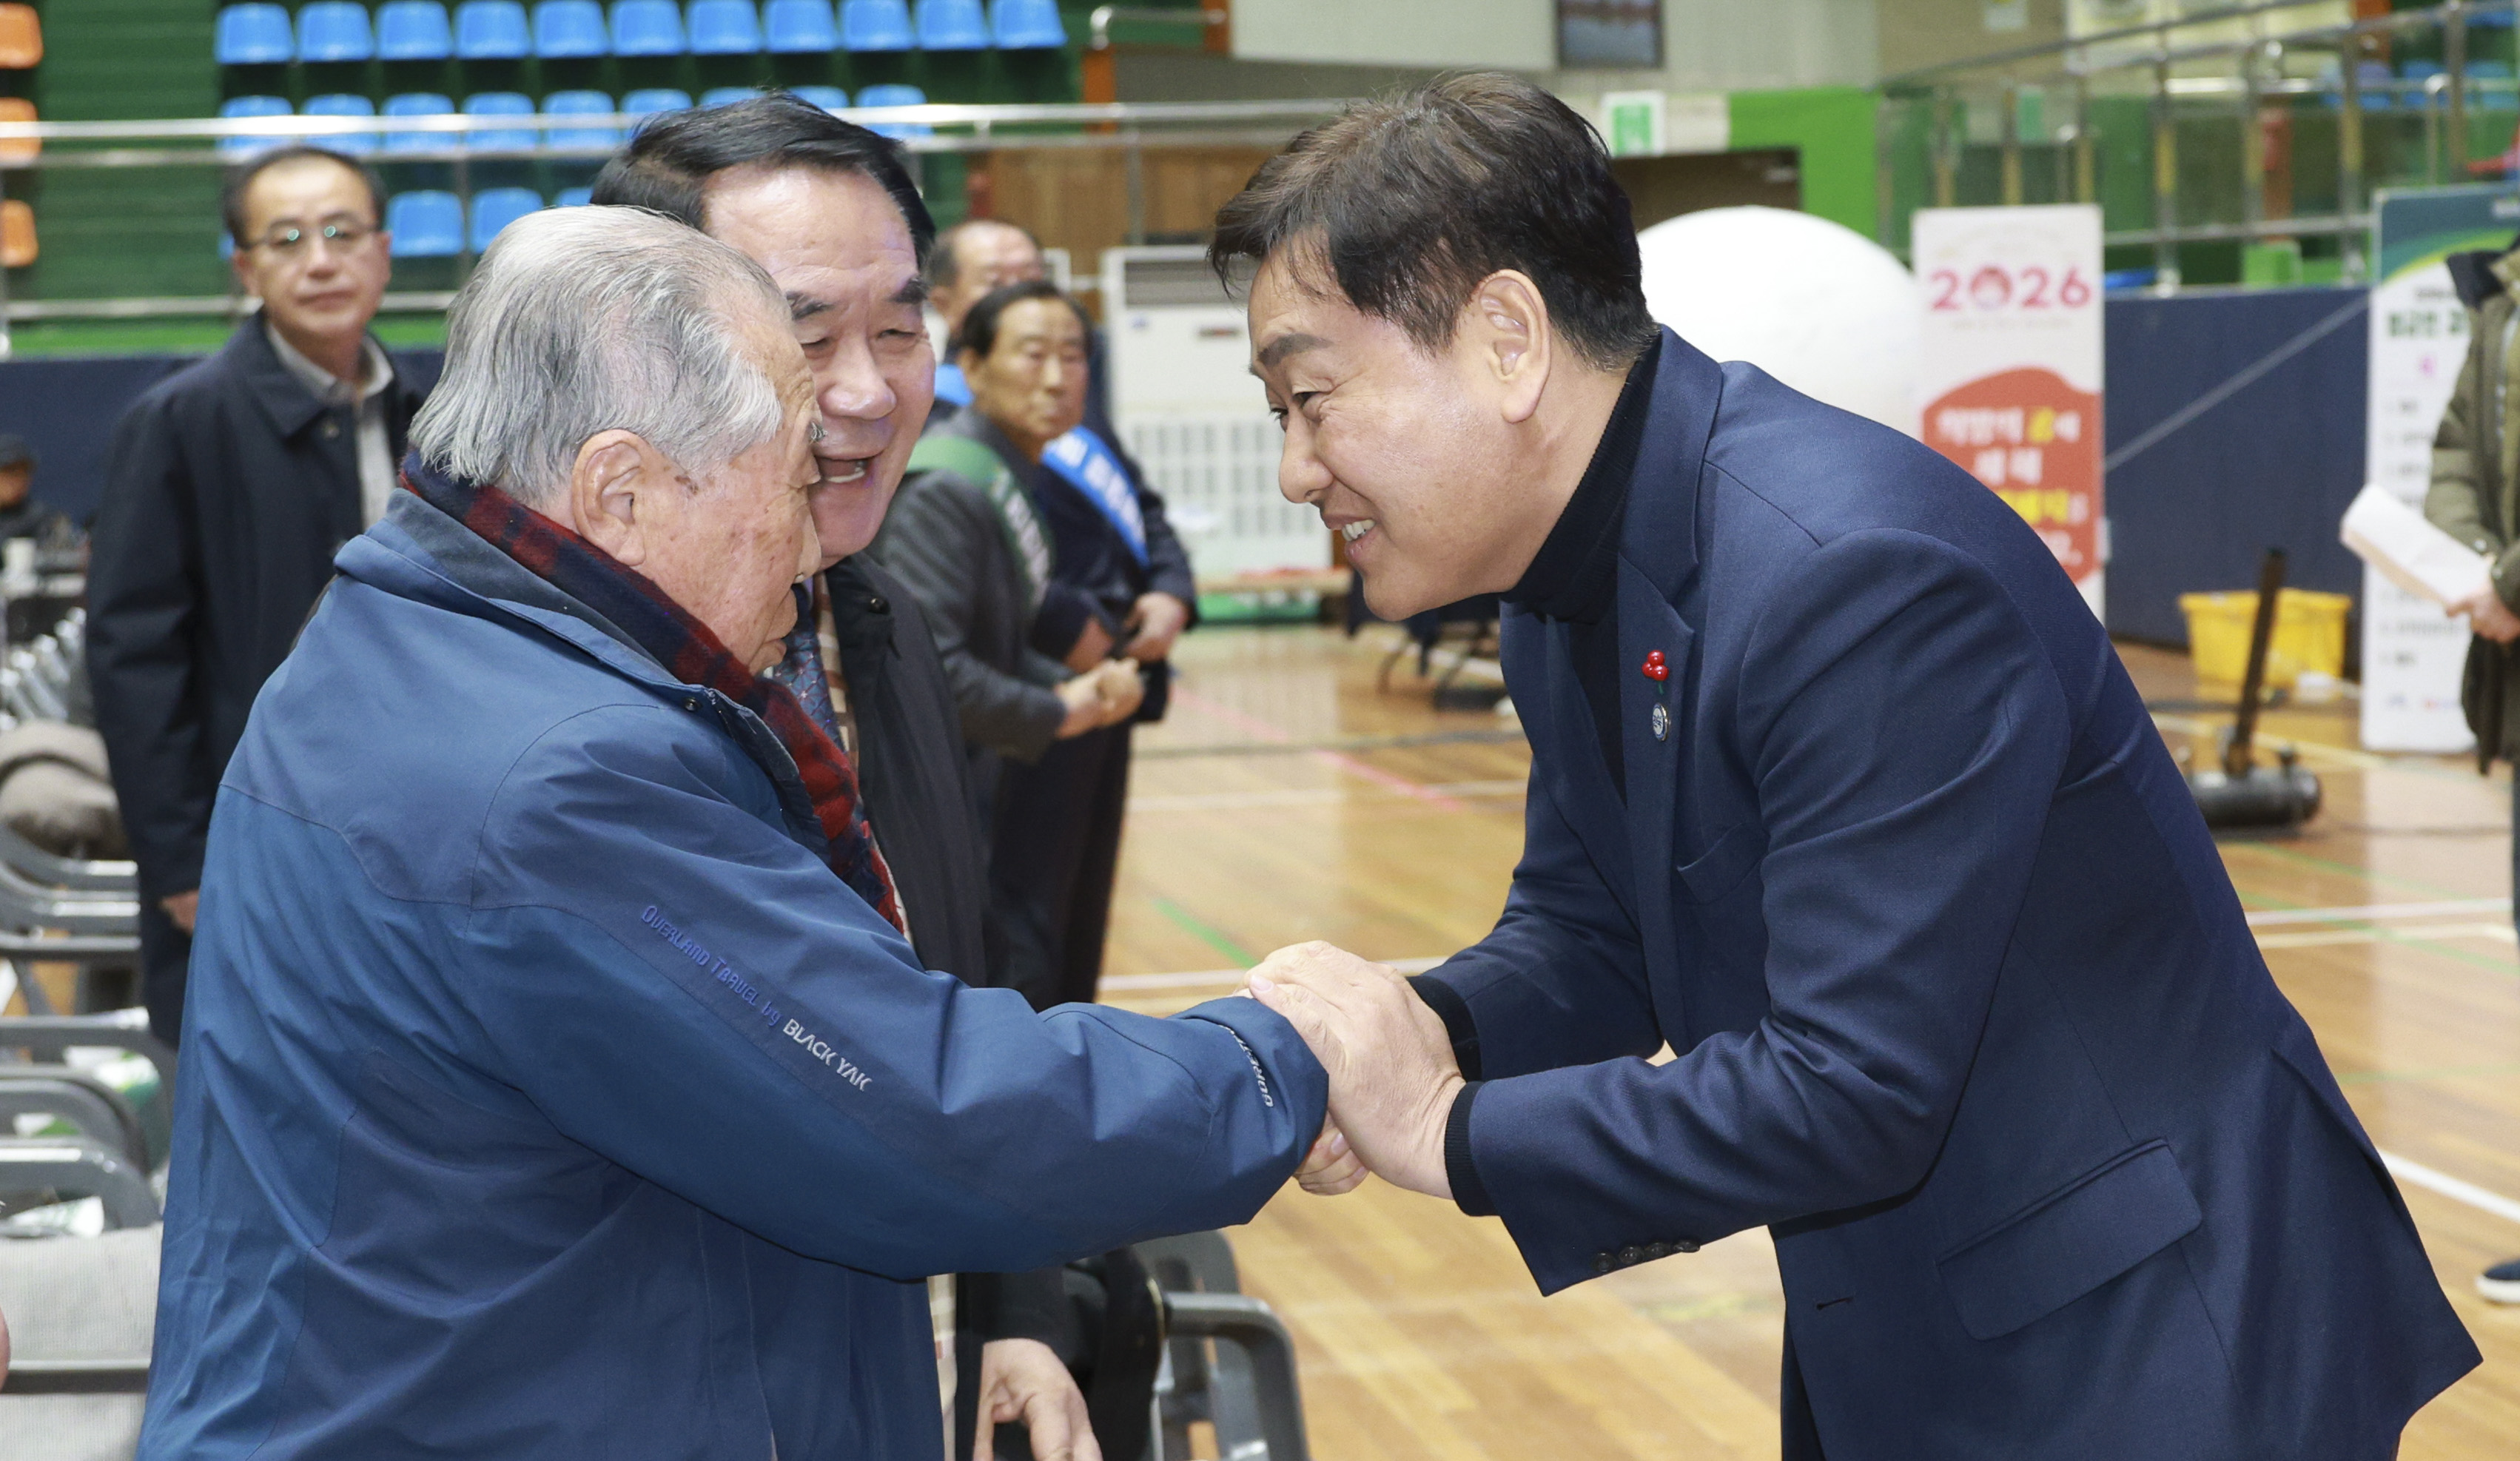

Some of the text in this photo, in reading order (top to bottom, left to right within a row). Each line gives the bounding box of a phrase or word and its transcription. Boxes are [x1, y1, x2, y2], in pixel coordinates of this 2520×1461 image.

[1930, 264, 2091, 310] 2026
[762, 1001, 782, 1027] by
[782, 1018, 838, 1067] BLACK
[836, 1057, 873, 1092] YAK
